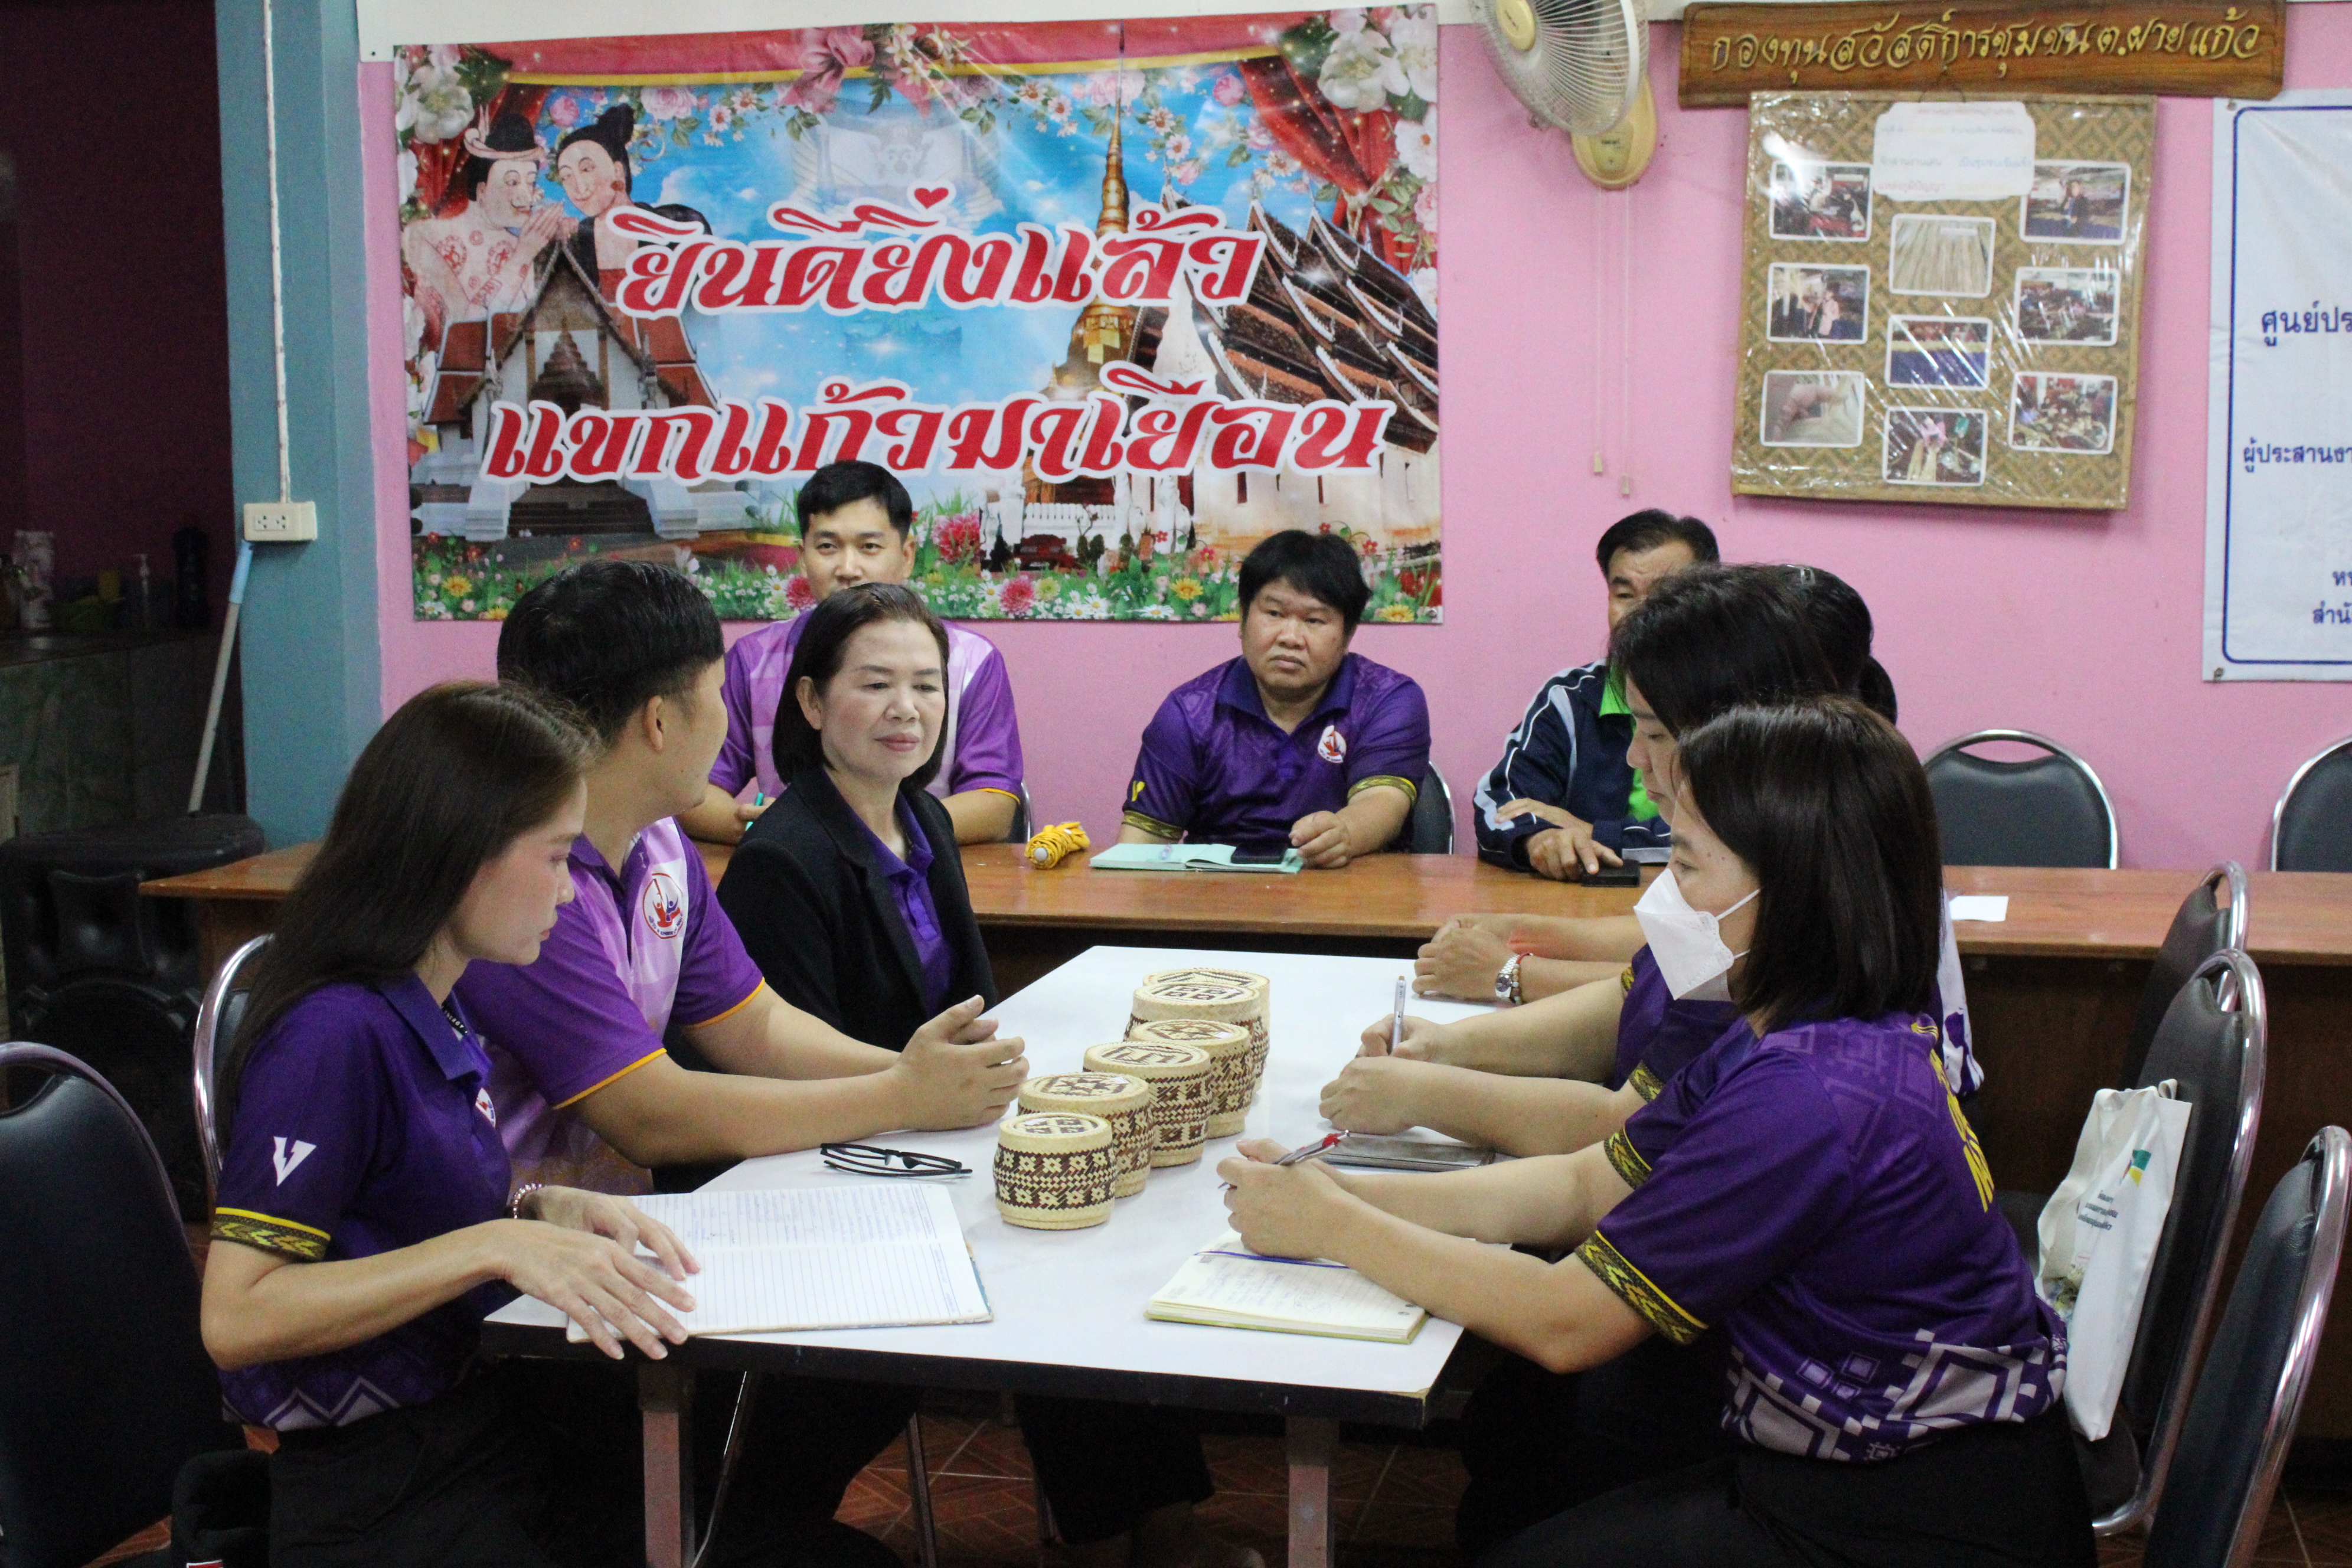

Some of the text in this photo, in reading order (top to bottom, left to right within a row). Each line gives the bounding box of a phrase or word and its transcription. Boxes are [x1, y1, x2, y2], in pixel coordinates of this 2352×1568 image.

[612, 187, 1259, 312] ยินดียิ่งแล้ว
[487, 368, 1390, 479] แขกแก้วมาเยือน
